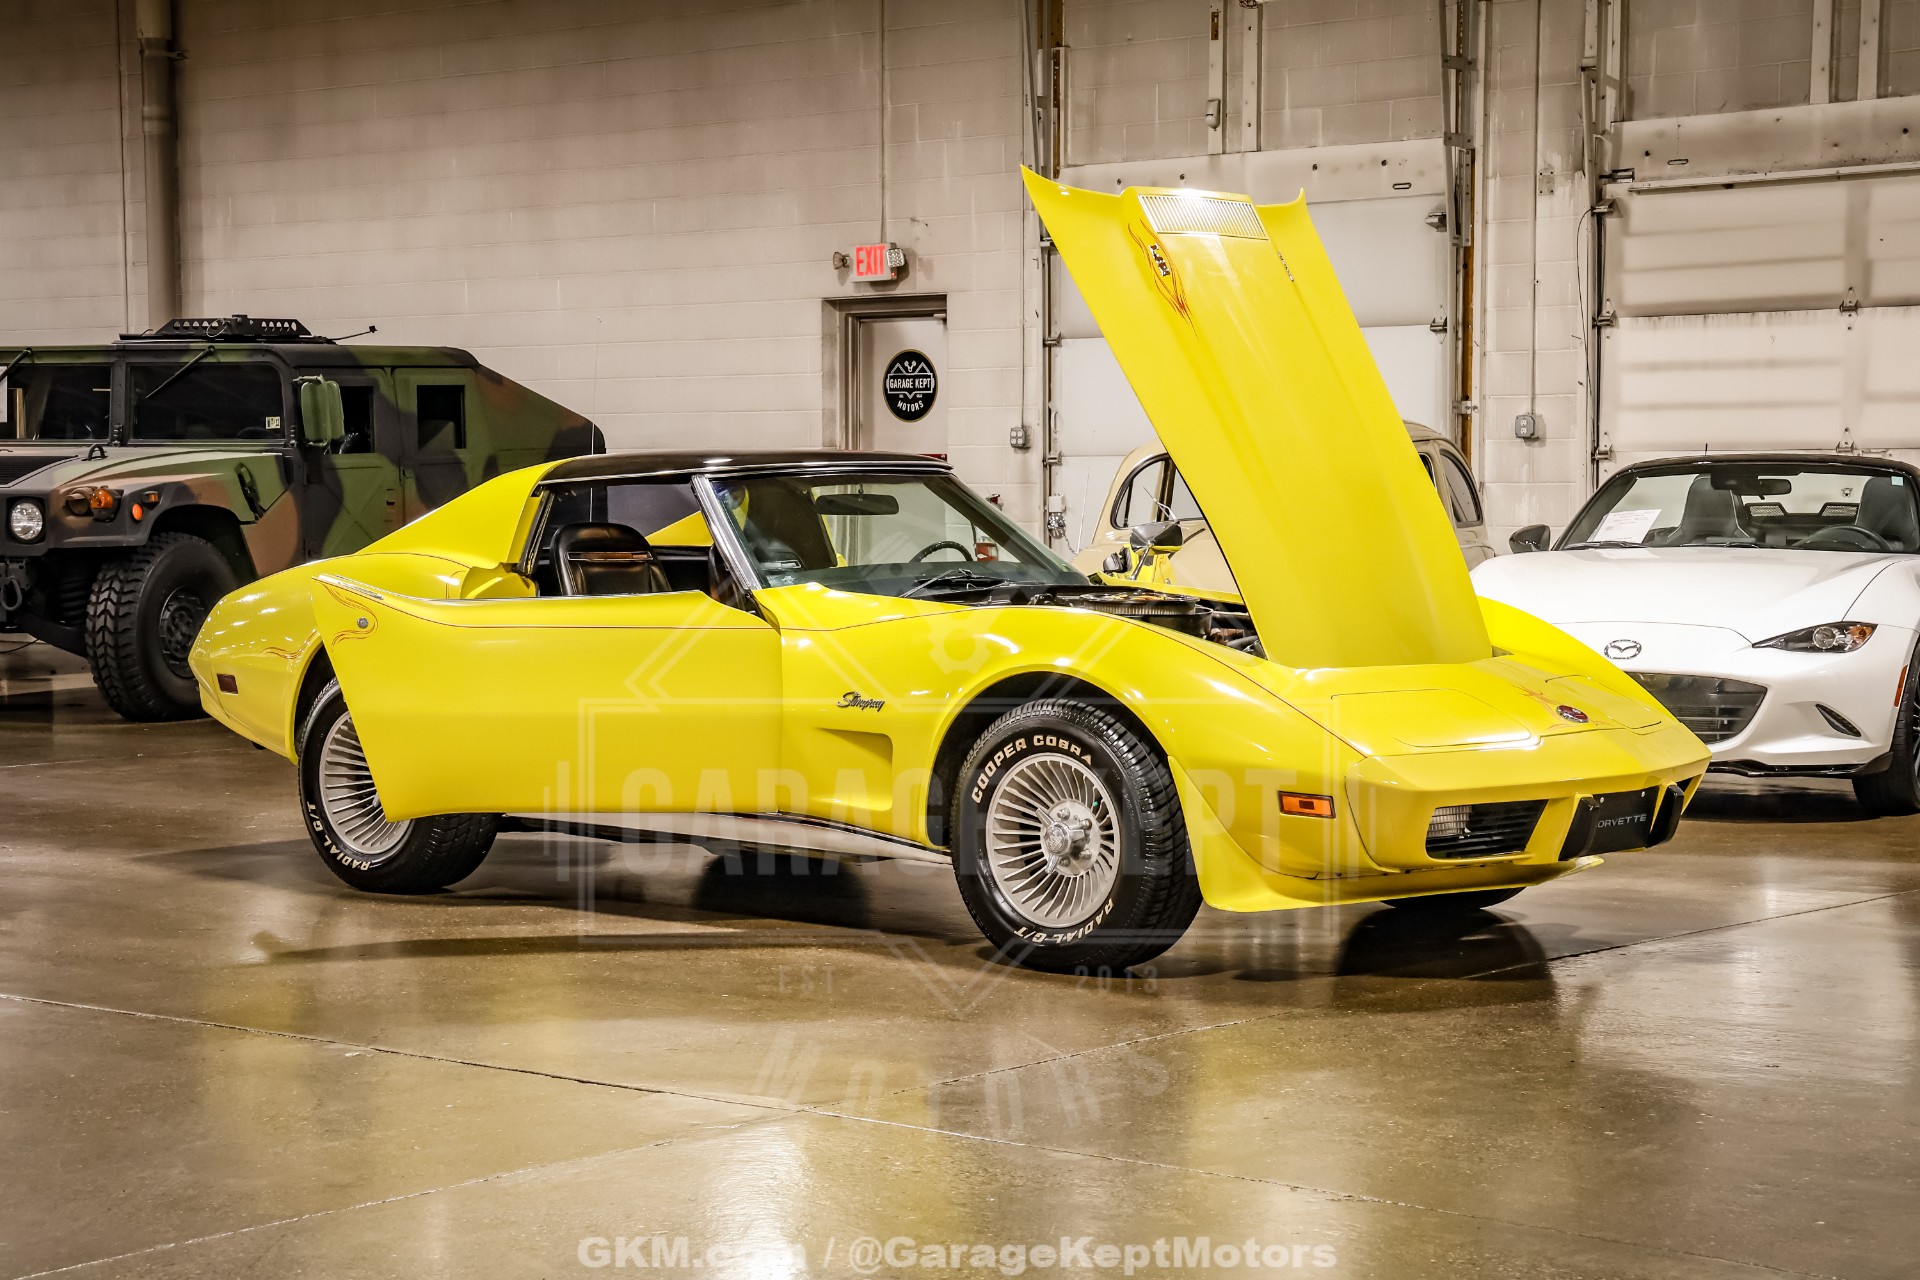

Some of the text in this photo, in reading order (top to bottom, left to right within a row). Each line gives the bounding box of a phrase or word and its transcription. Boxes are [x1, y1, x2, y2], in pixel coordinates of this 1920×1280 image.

[856, 244, 887, 277] EXIT
[889, 377, 931, 389] GARAGE KEPT
[896, 400, 924, 412] MOTORS
[836, 691, 886, 712] Stingray
[971, 734, 1092, 804] COOPER COBRA
[1597, 813, 1648, 829] ORVETTE
[323, 834, 372, 871] RADIAL
[1053, 898, 1114, 944] RADIAL
